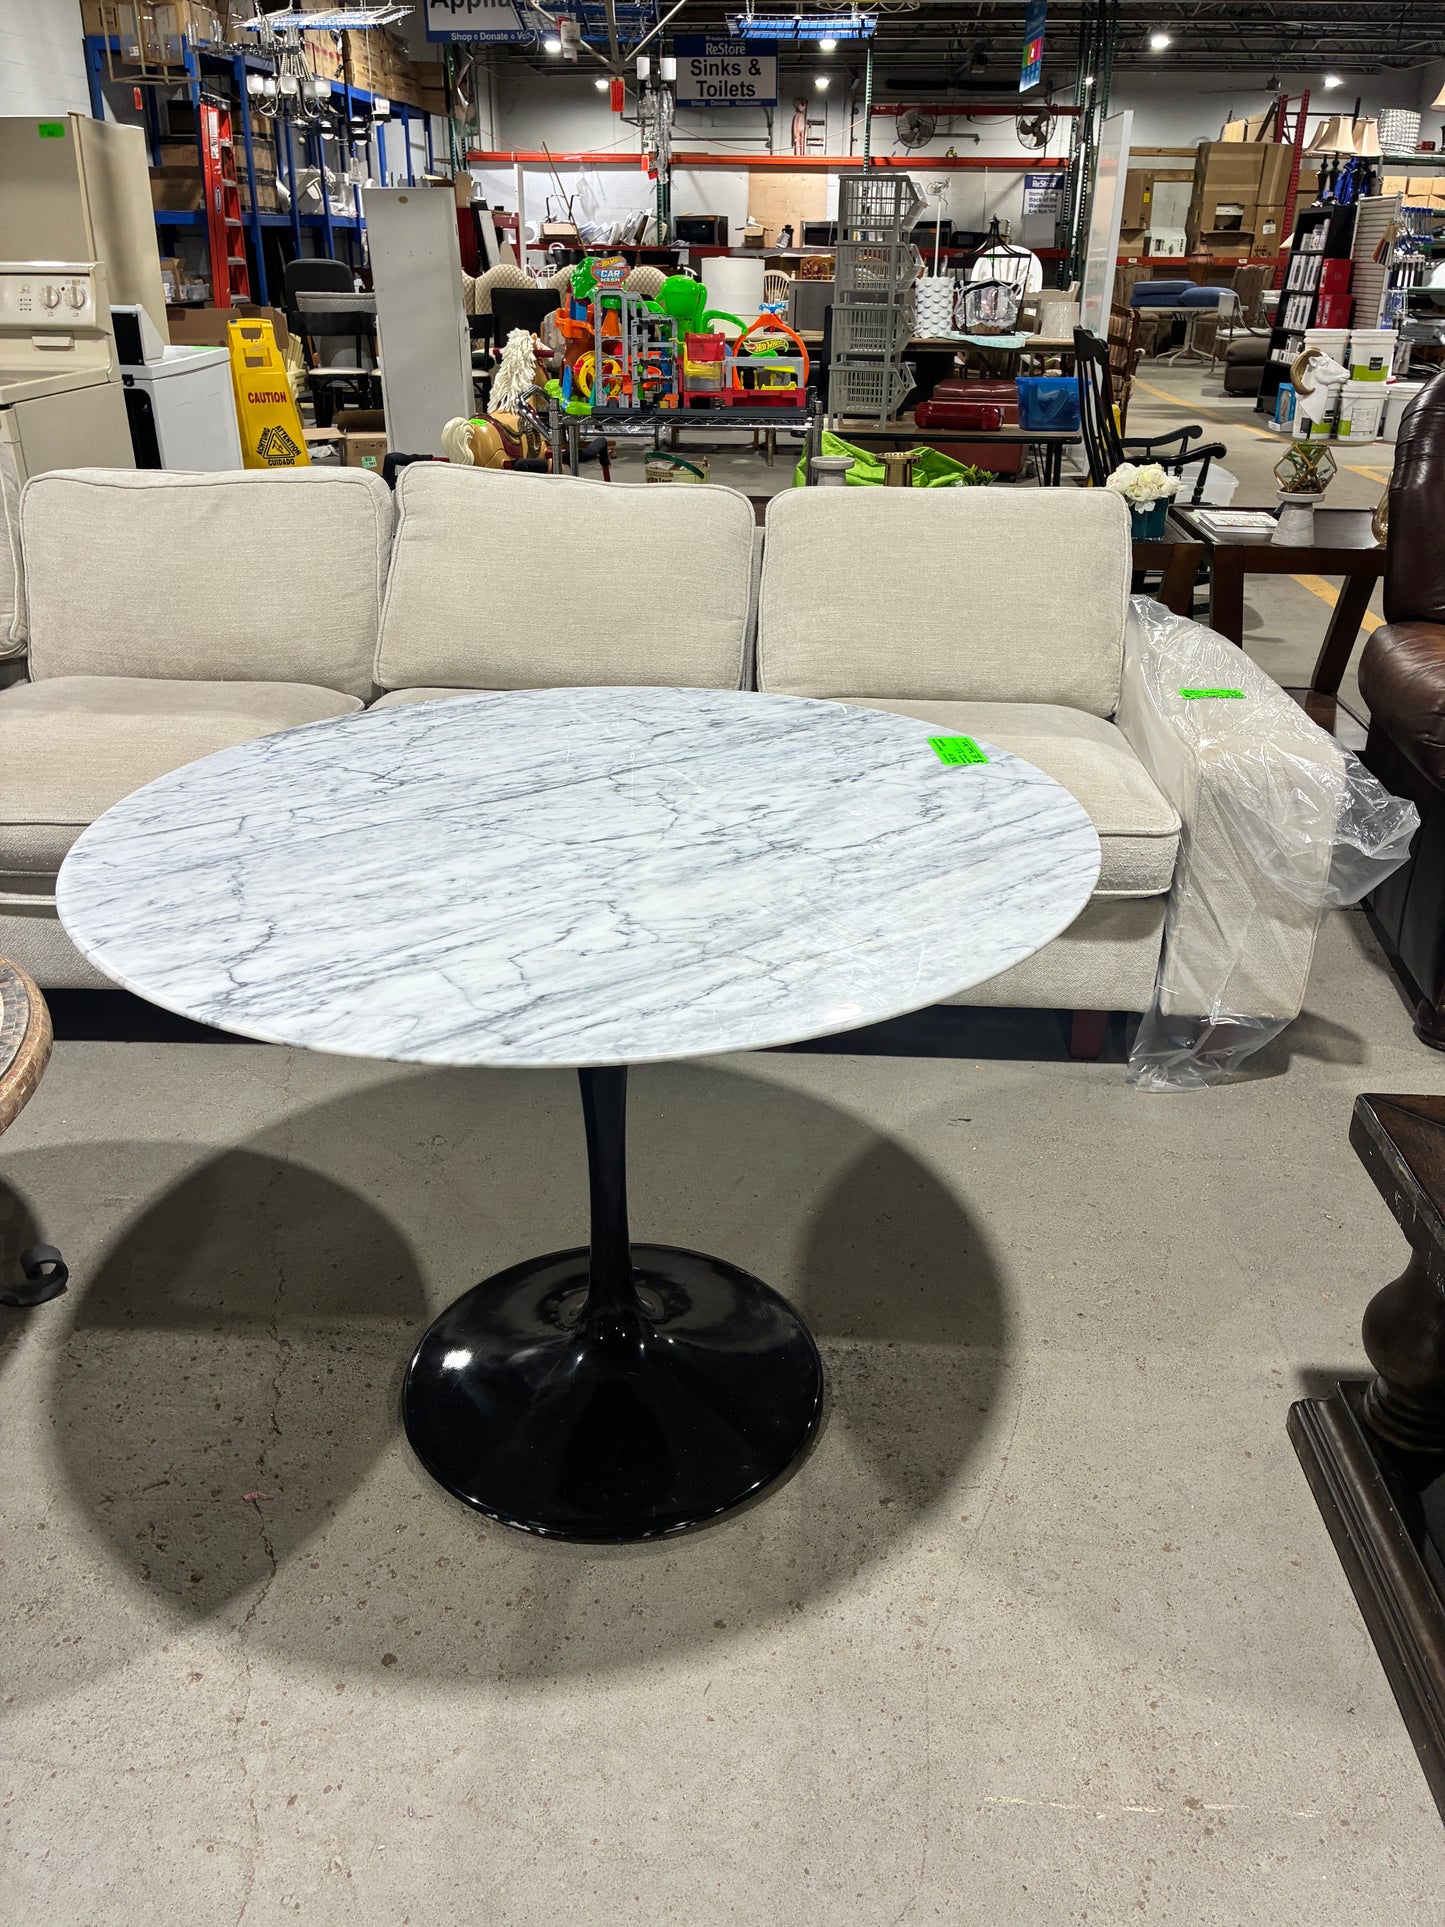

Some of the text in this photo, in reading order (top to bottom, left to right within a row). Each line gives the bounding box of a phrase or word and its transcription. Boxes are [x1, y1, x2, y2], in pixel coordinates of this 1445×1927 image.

[451, 32, 472, 41] Shop
[480, 32, 508, 40] Donate
[705, 43, 746, 55] ReStore
[690, 59, 762, 76] Sinks &
[696, 80, 756, 97] Toilets
[600, 270, 621, 278] CAR
[248, 391, 287, 404] CAUTION
[256, 427, 271, 456] ACHTUNG
[275, 425, 302, 456] ATTENTION
[268, 458, 295, 467] CUIDADO
